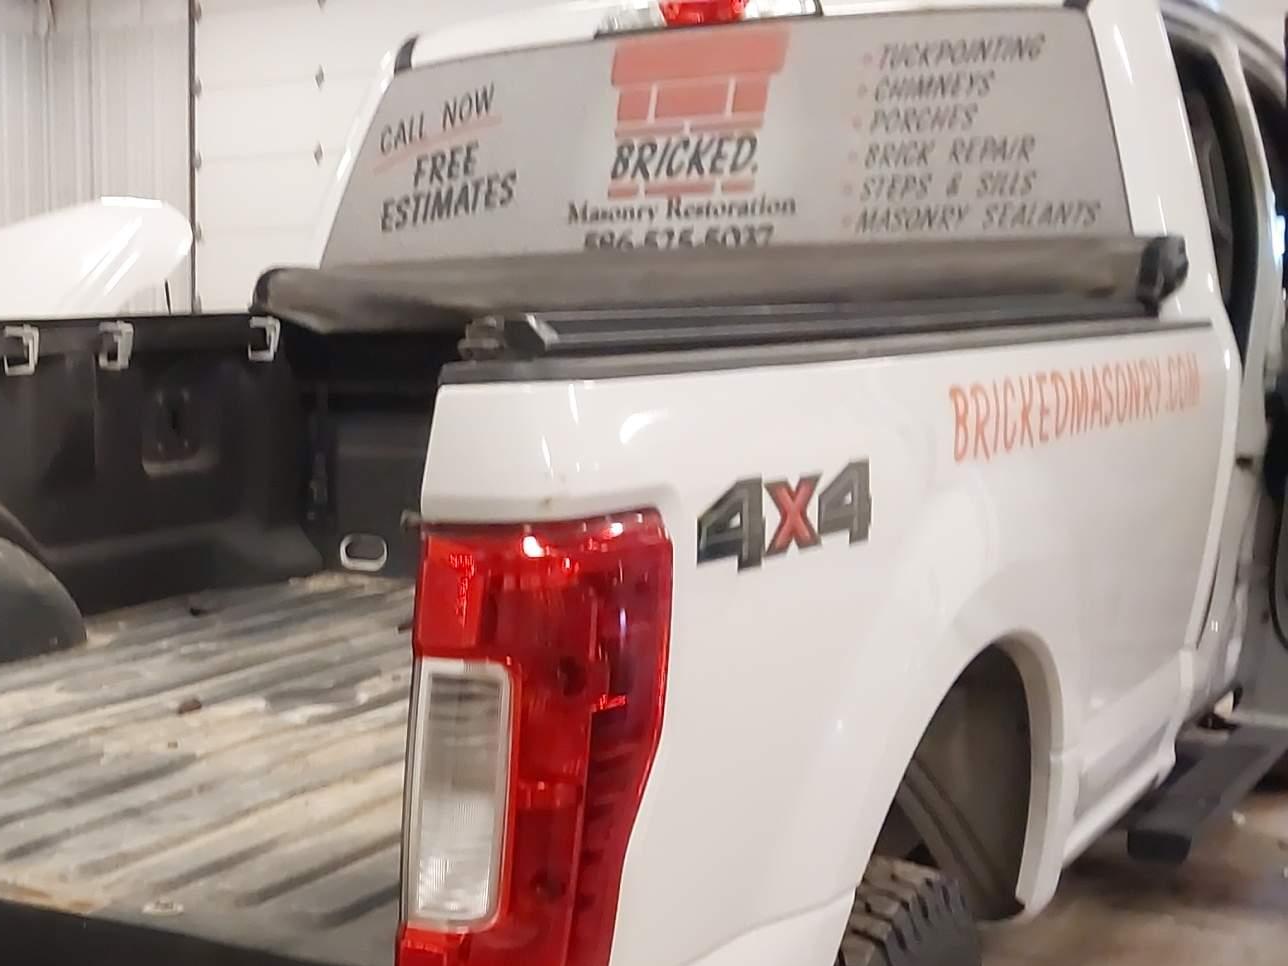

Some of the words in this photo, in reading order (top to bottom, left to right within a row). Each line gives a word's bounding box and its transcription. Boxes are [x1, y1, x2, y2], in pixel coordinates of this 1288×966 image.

[874, 71, 996, 102] CHIMNEYS
[379, 114, 425, 154] CALL
[442, 81, 495, 132] NOW
[869, 104, 979, 134] PORCHES
[413, 142, 480, 188] FREE
[864, 141, 936, 169] BRICK
[948, 136, 1036, 163] REPAIR
[380, 171, 518, 232] ESTIMATES
[861, 173, 933, 200] STEPS
[567, 201, 657, 226] Masonry
[666, 197, 798, 219] Restoration
[855, 206, 969, 233] MASONRY
[982, 202, 1101, 229] SEALANTS
[949, 352, 1200, 463] BRICKEDMASONRY.COM
